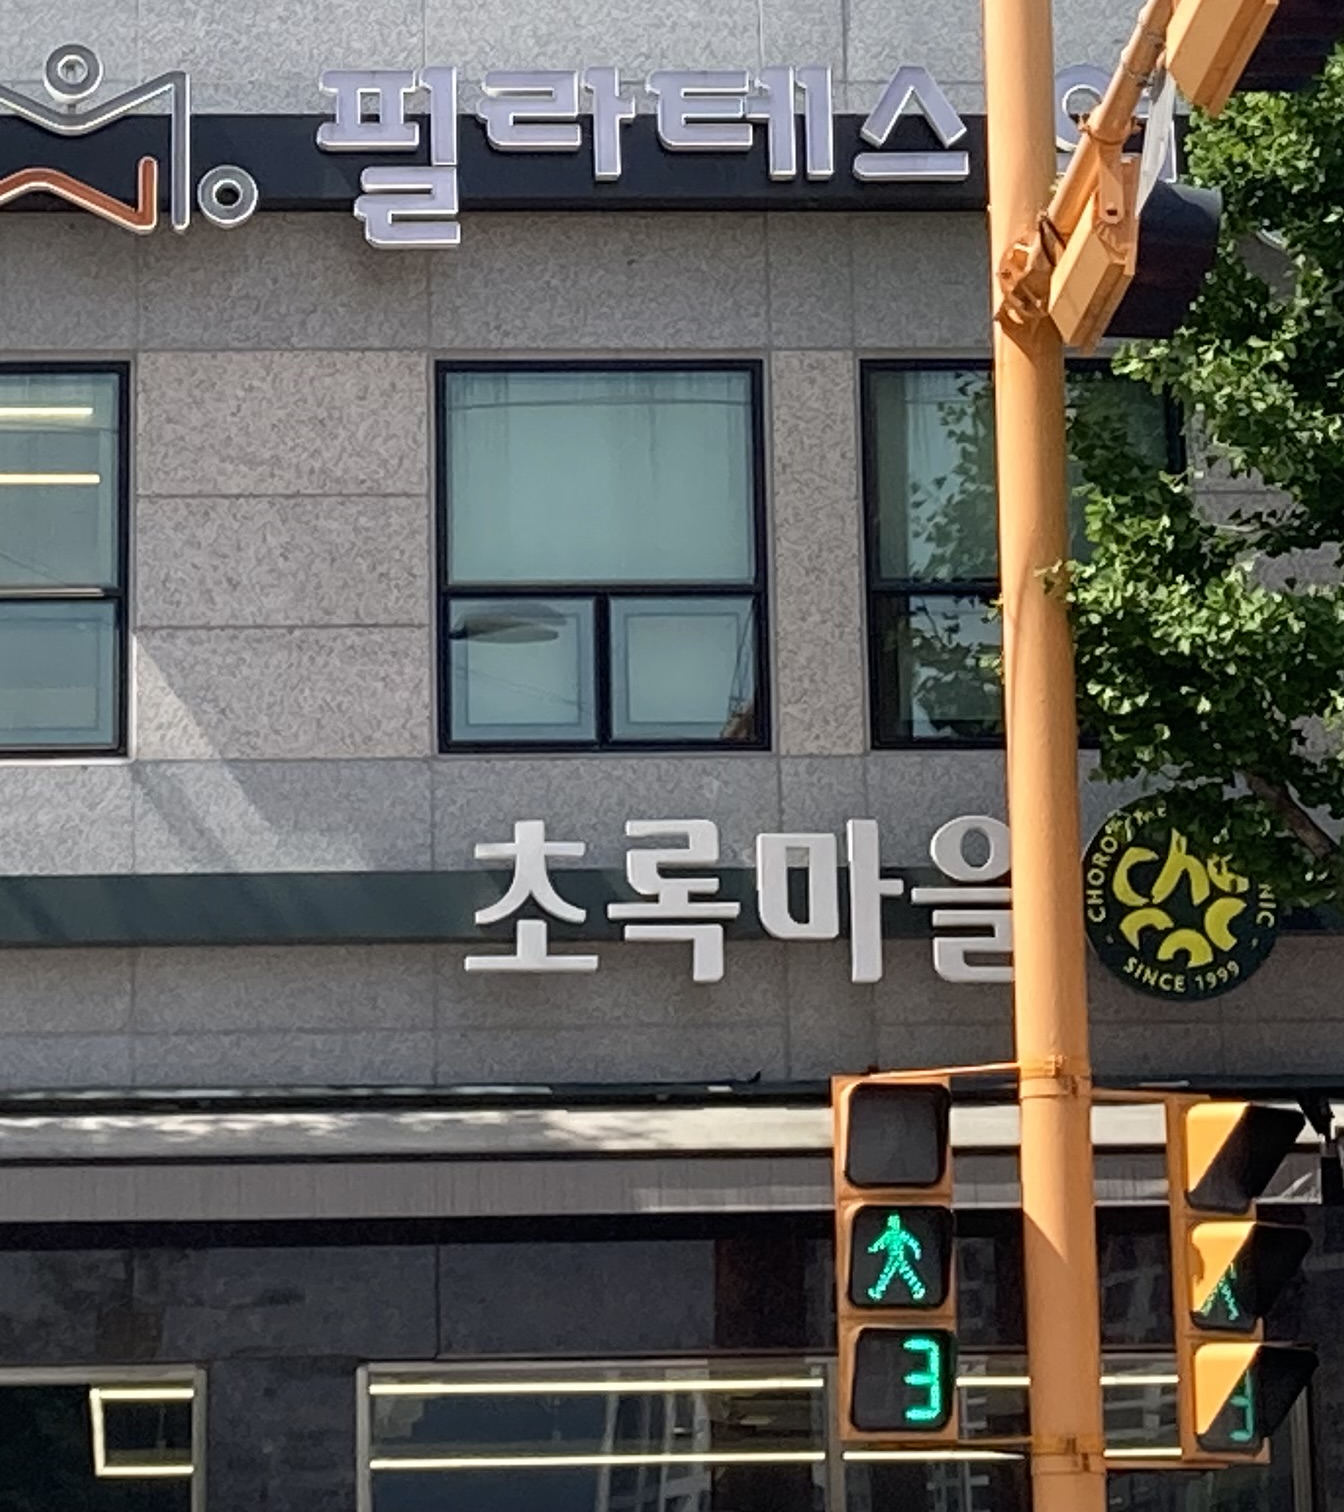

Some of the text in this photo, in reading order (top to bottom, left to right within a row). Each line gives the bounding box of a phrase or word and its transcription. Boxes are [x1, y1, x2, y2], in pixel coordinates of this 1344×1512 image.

[316, 64, 970, 248] 필라테스
[464, 815, 1015, 983] 초록마을
[1086, 822, 1122, 923] CHORO
[1122, 957, 1240, 993] SINCE 1999
[903, 1336, 940, 1424] 3
